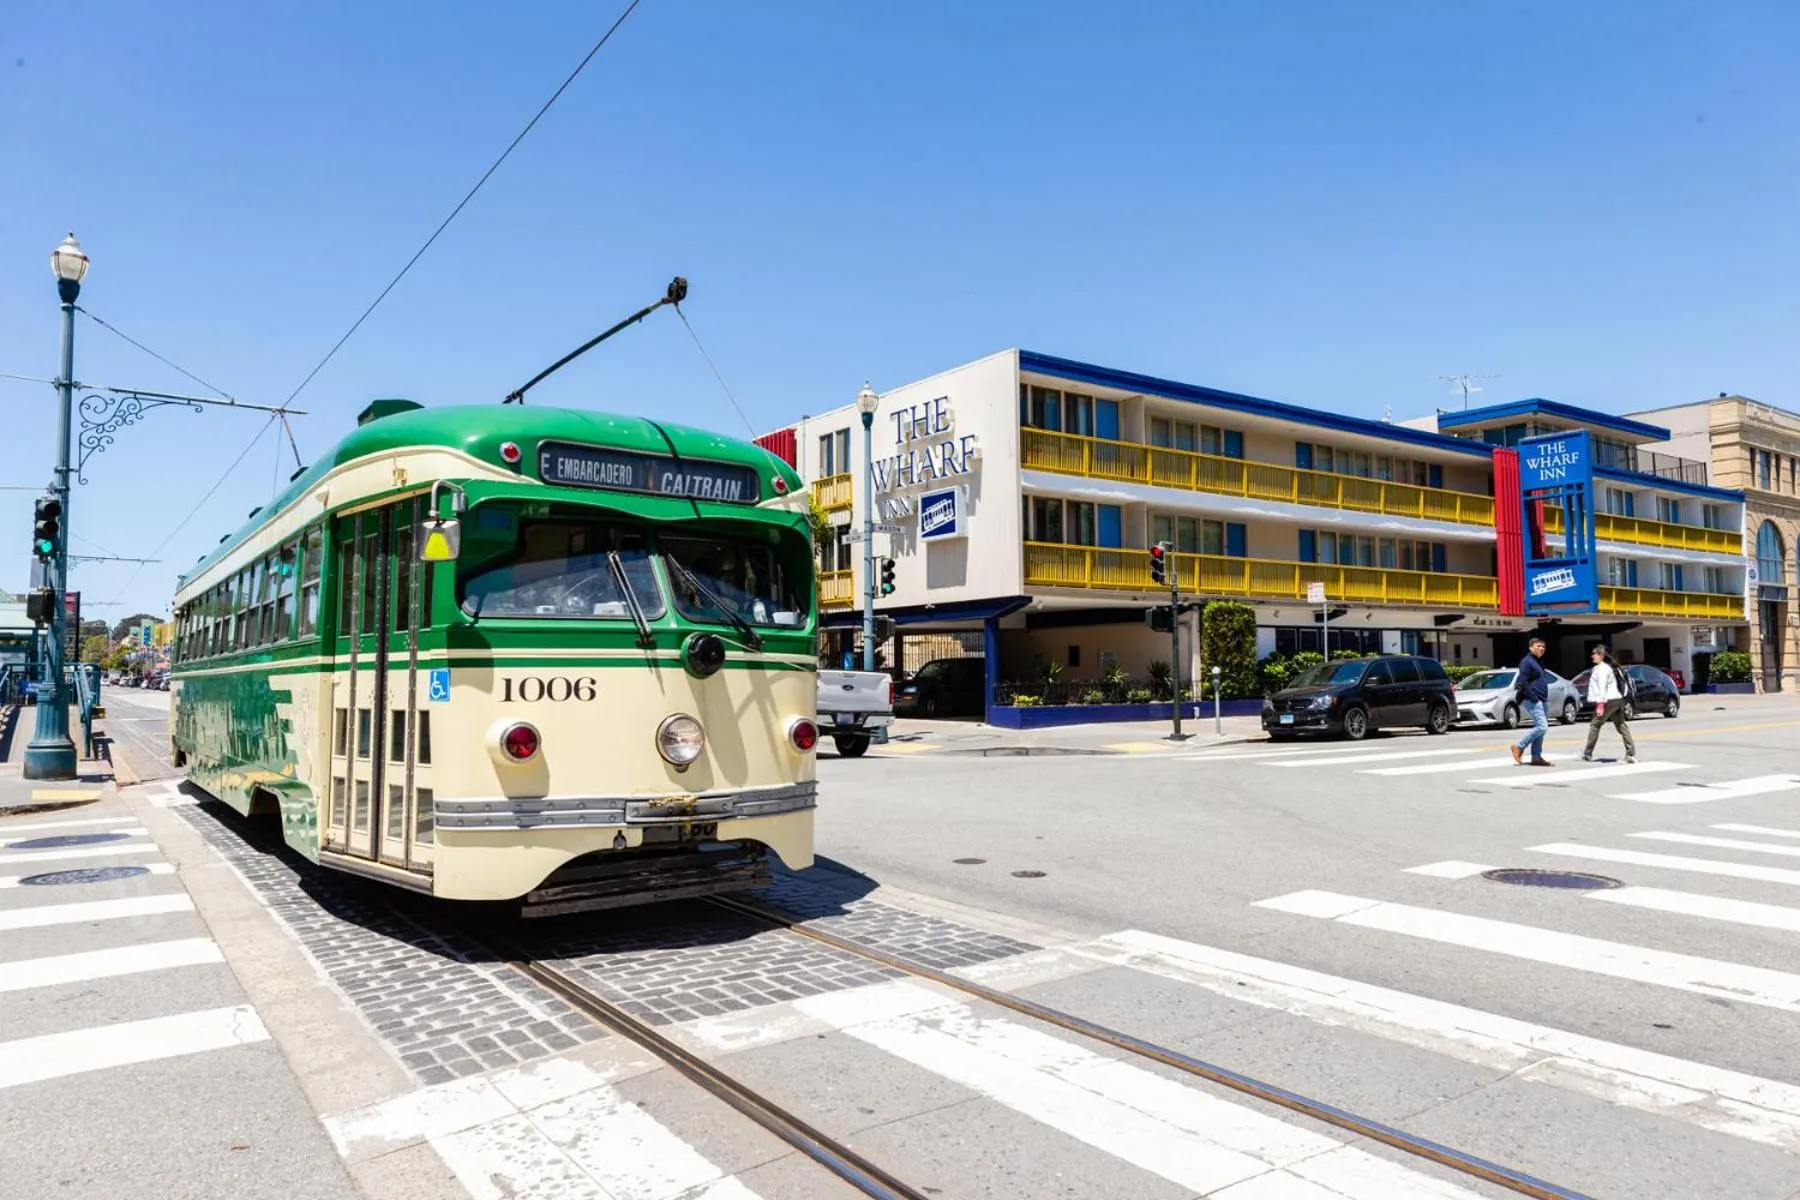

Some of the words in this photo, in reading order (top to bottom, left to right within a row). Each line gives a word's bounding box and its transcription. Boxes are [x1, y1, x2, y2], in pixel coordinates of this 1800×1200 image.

[890, 395, 950, 444] THE
[1526, 452, 1579, 469] WHARF
[1537, 441, 1566, 456] THE
[870, 434, 976, 491] WHARF
[1540, 466, 1566, 480] INN
[541, 453, 550, 478] E
[557, 457, 633, 486] EMBARCADERO
[660, 472, 742, 501] CALTRAIN
[498, 677, 597, 703] 1006
